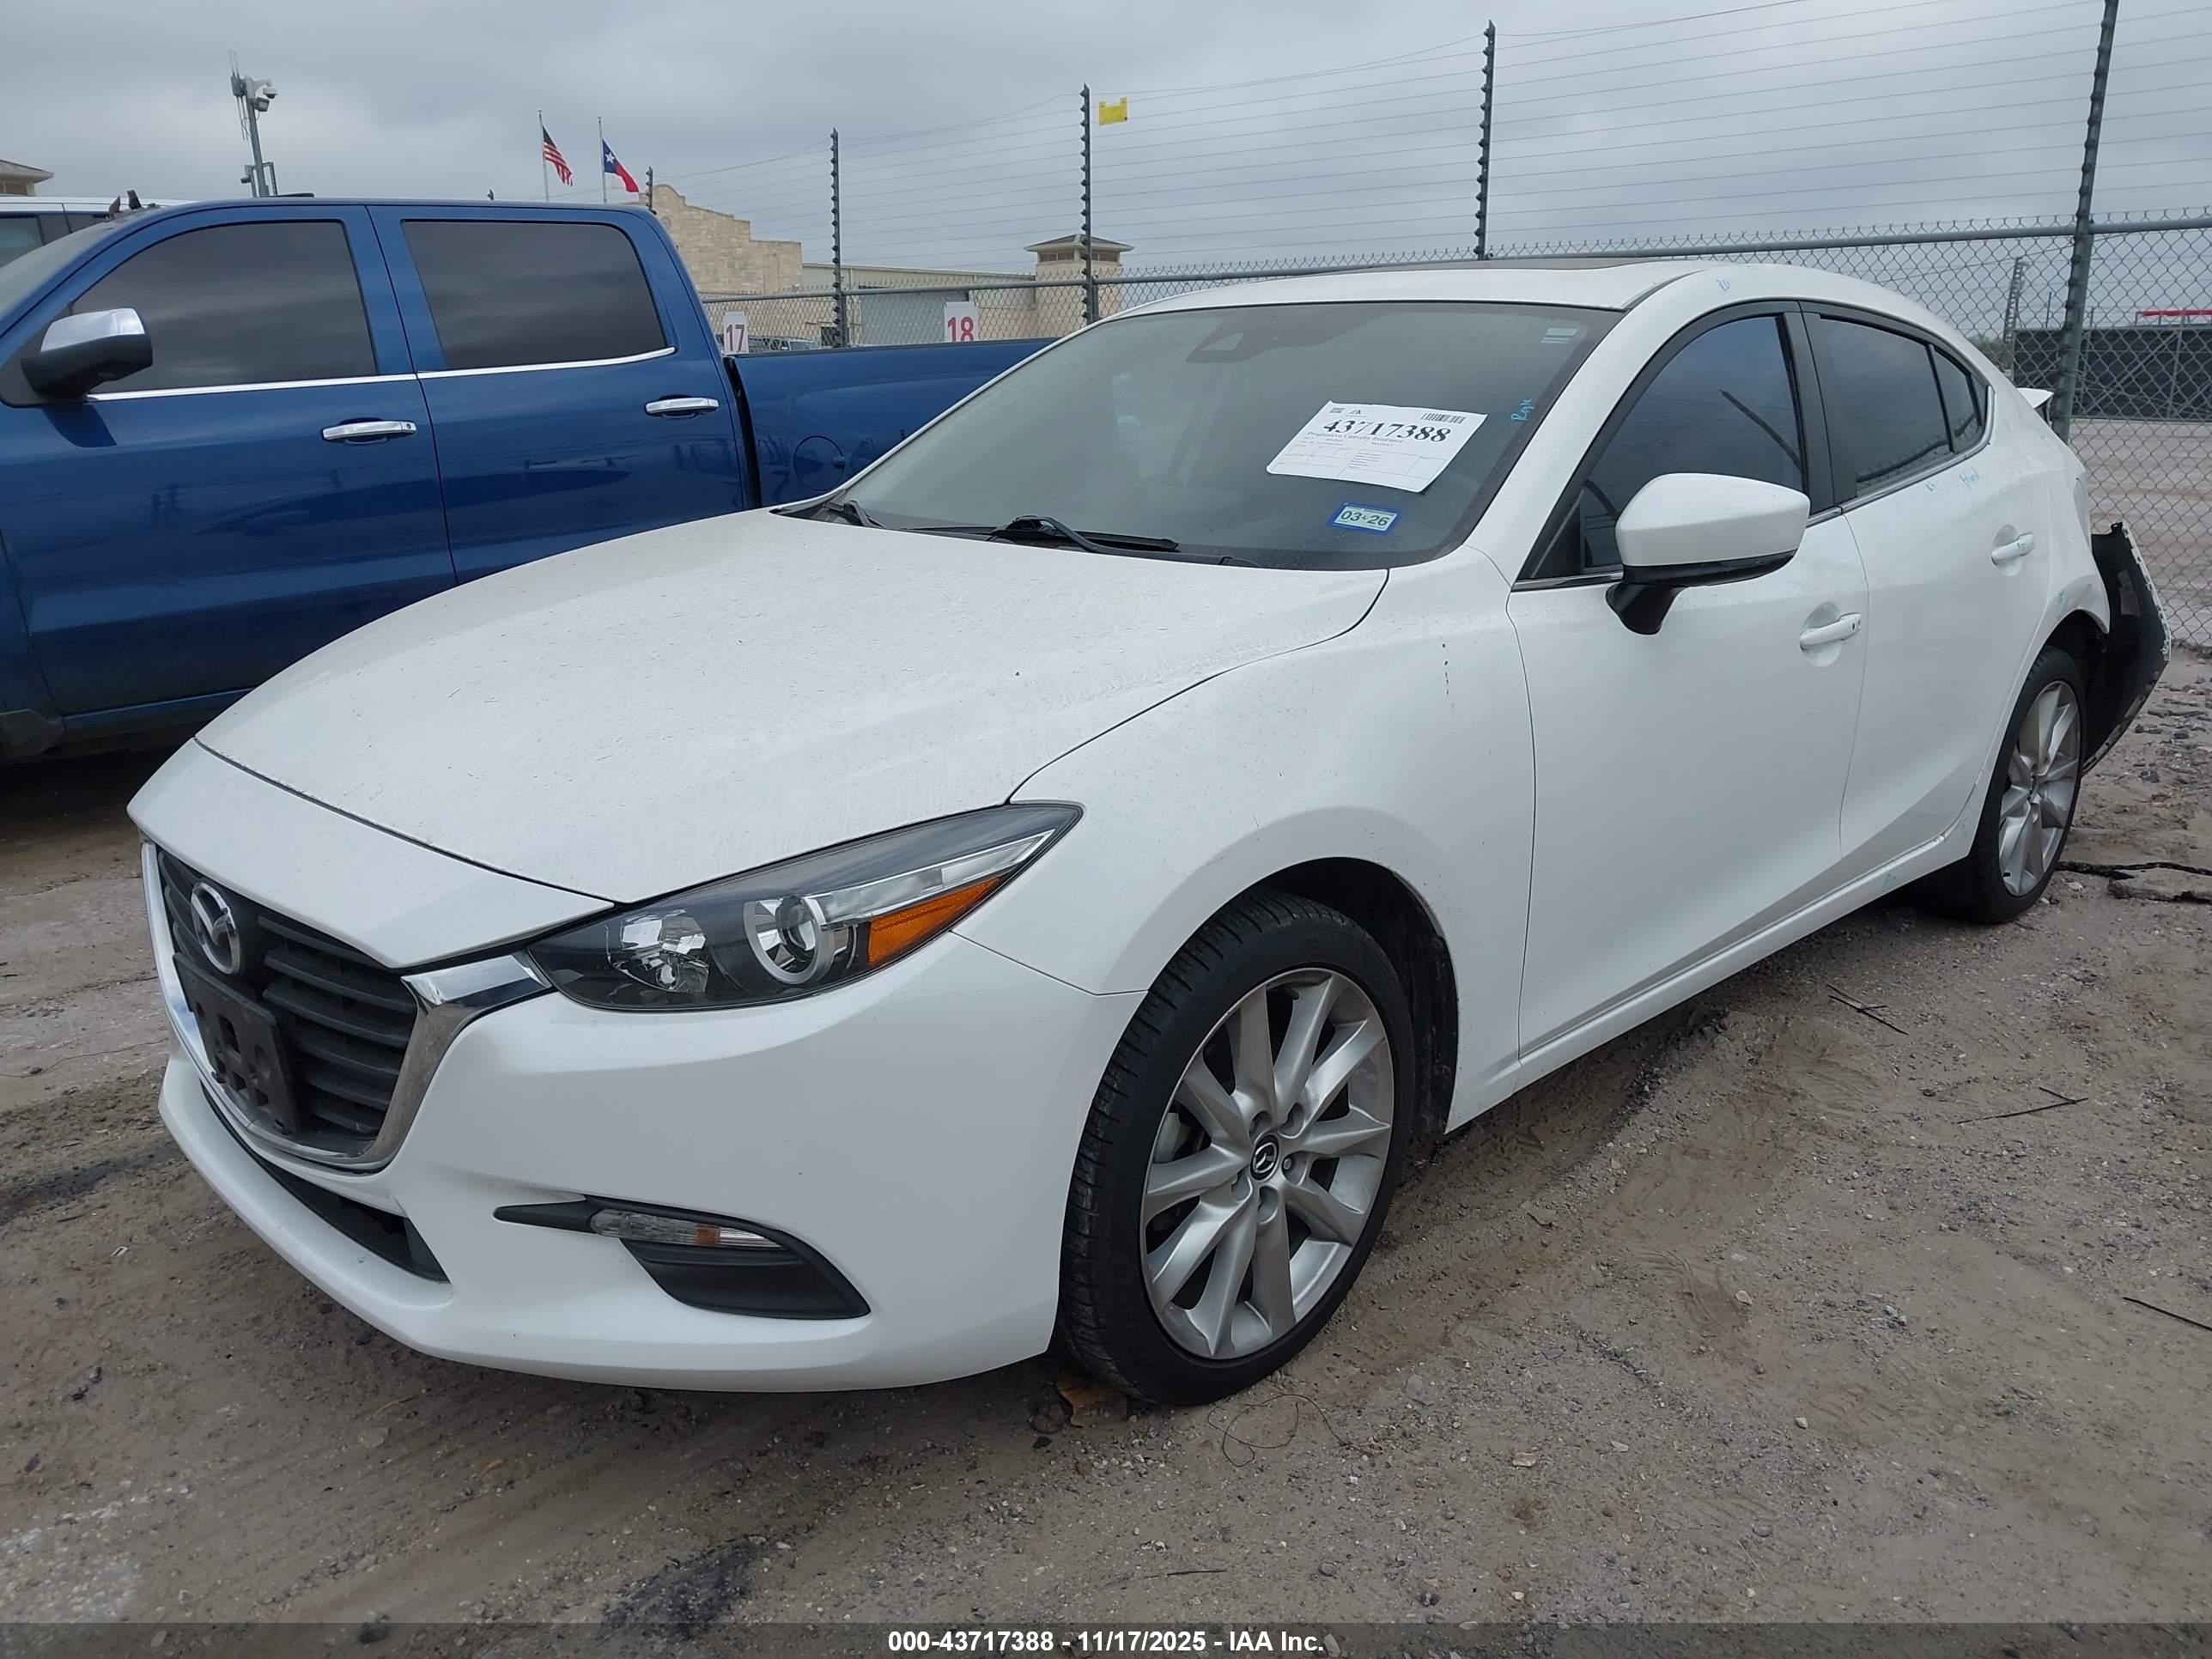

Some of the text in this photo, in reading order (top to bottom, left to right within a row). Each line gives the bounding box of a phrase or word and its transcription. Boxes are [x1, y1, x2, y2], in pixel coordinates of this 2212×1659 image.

[726, 324, 744, 352] 17
[947, 316, 974, 342] 18
[1323, 419, 1451, 442] 43717388
[1340, 511, 1390, 526] 03 26
